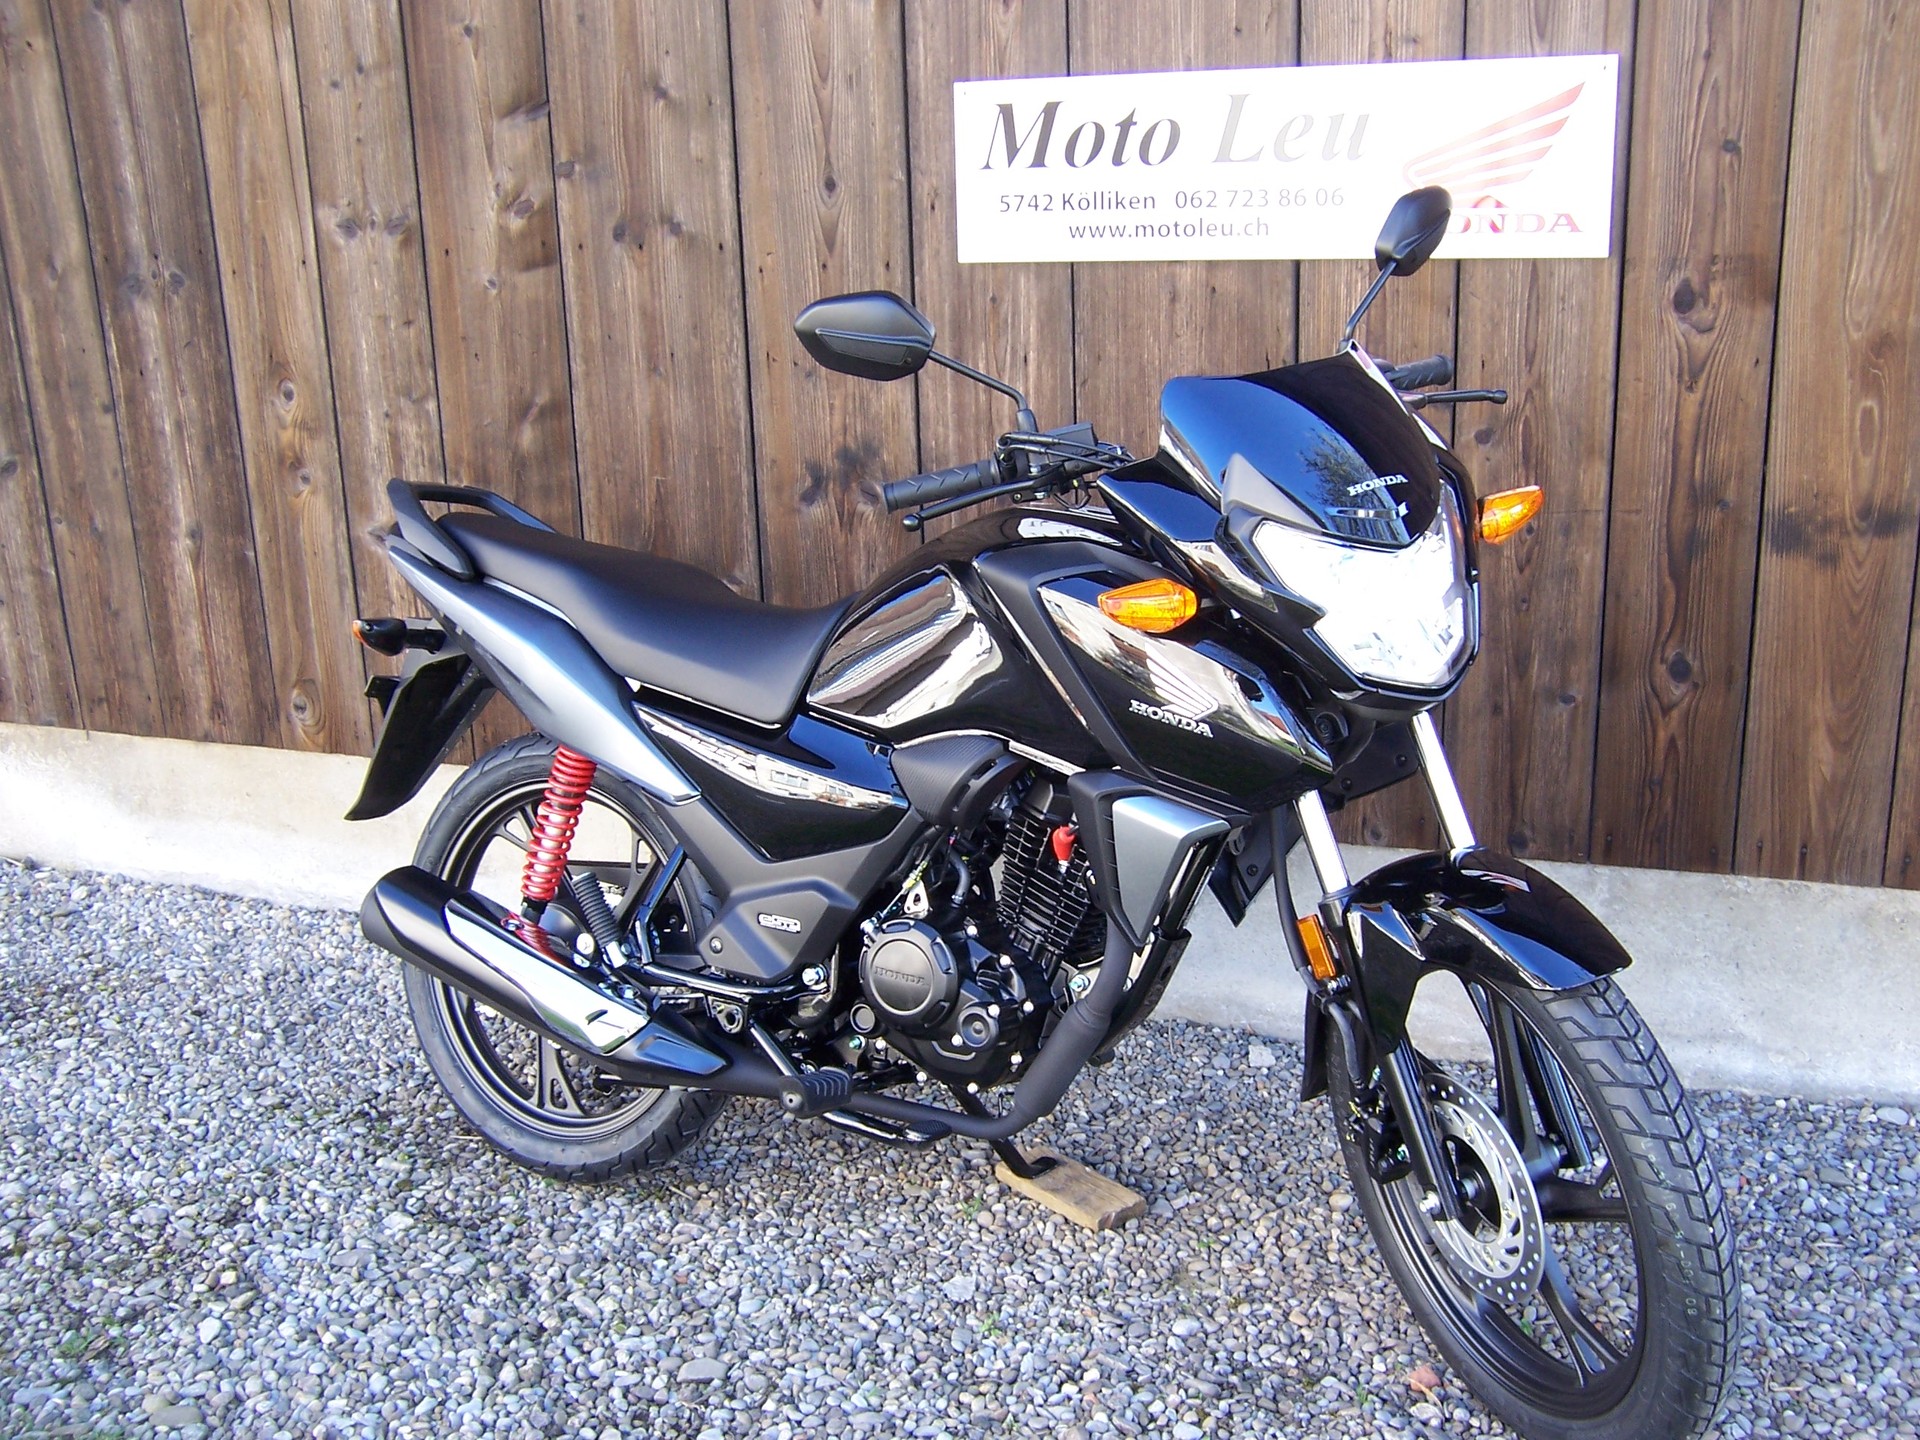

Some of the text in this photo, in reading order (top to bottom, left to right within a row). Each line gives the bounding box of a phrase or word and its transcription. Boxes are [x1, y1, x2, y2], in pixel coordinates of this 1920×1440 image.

[980, 93, 1371, 171] Moto Leu
[999, 188, 1345, 213] 5742 Kölliken 062 723 86 06
[1068, 217, 1270, 239] www.motoleu.ch
[1447, 213, 1583, 234] ONDA
[1346, 474, 1408, 497] HONDA
[1128, 699, 1214, 738] HONDA
[874, 966, 929, 986] HONDA
